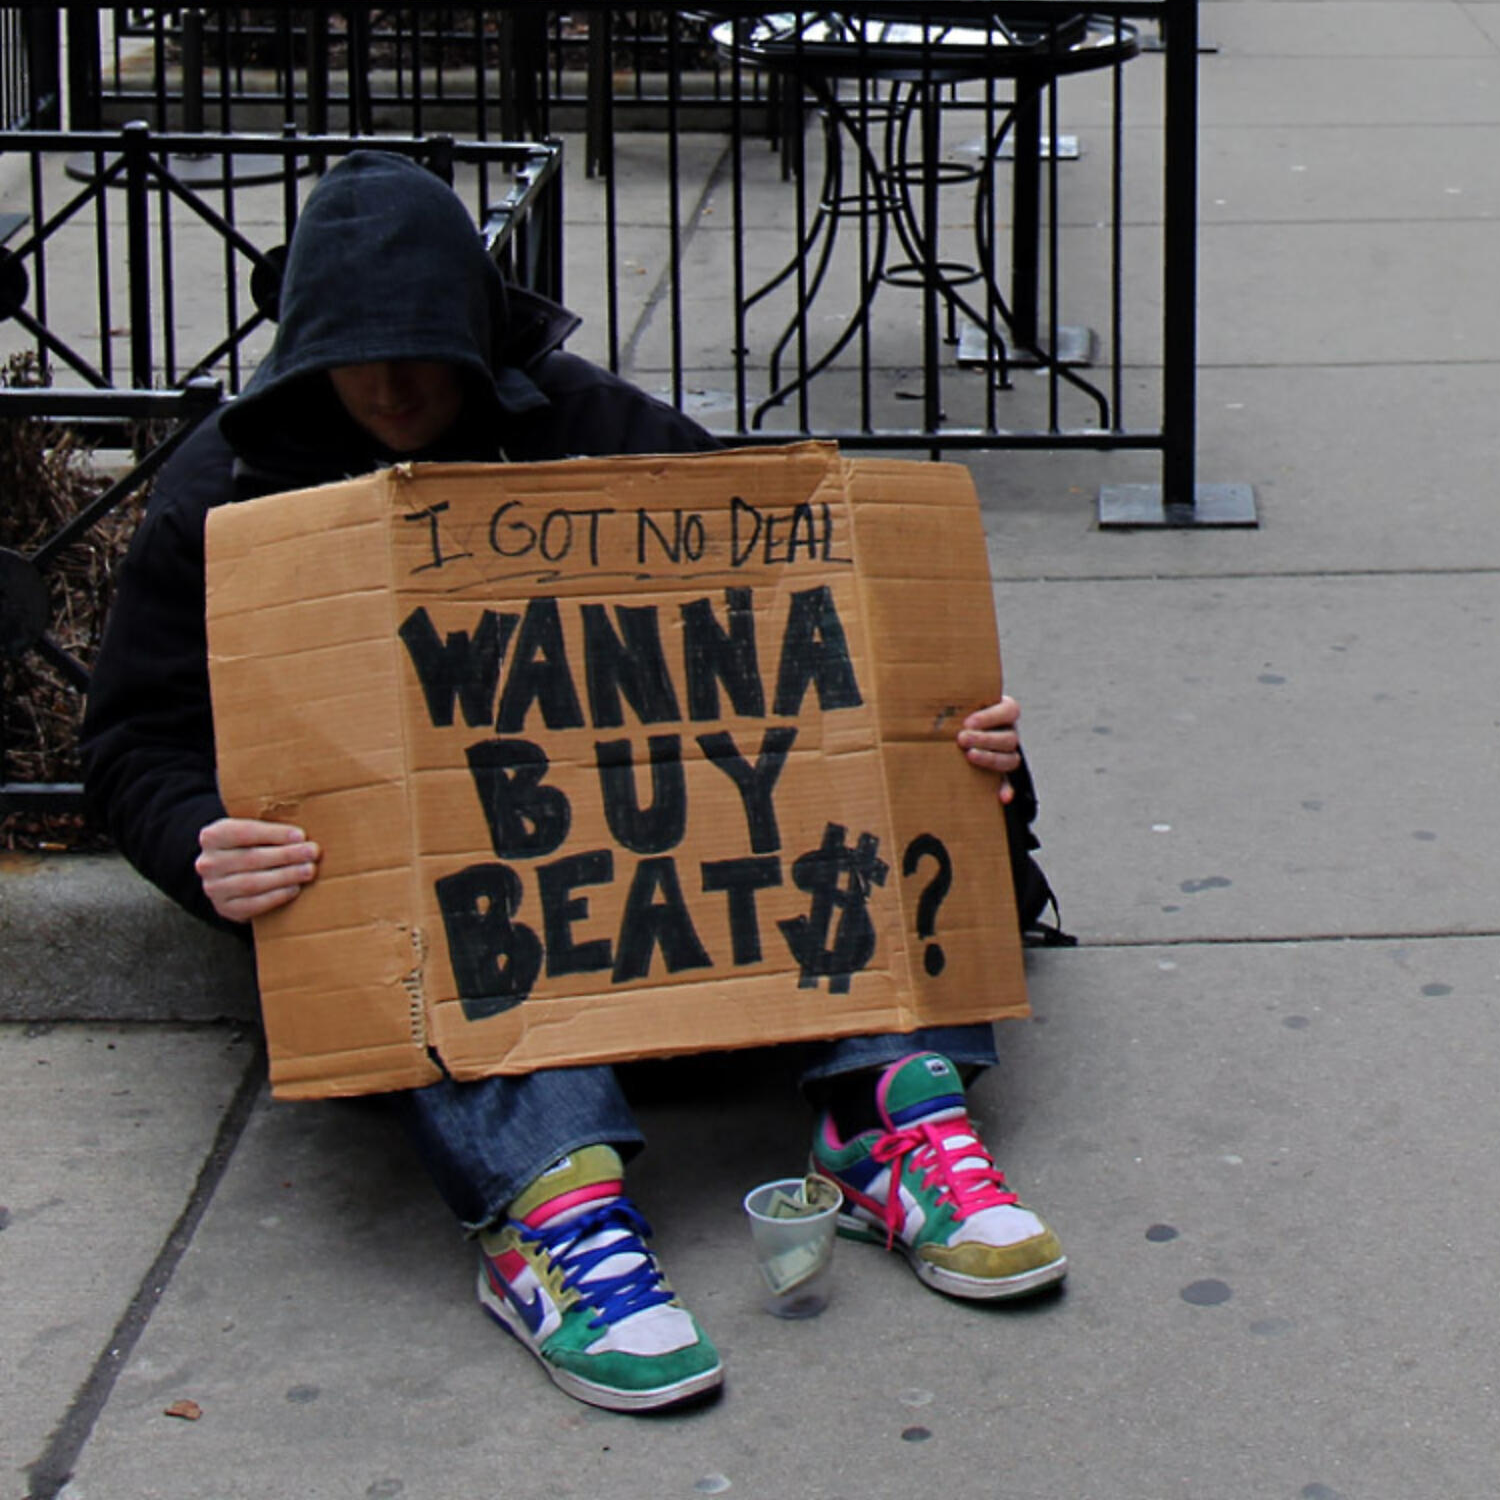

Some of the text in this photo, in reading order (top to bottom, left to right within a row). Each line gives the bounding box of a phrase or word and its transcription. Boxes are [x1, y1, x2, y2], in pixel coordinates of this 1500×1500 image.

[404, 497, 854, 576] I GOT NO DEAL
[398, 584, 865, 734] WANNA
[464, 726, 798, 860] BUY
